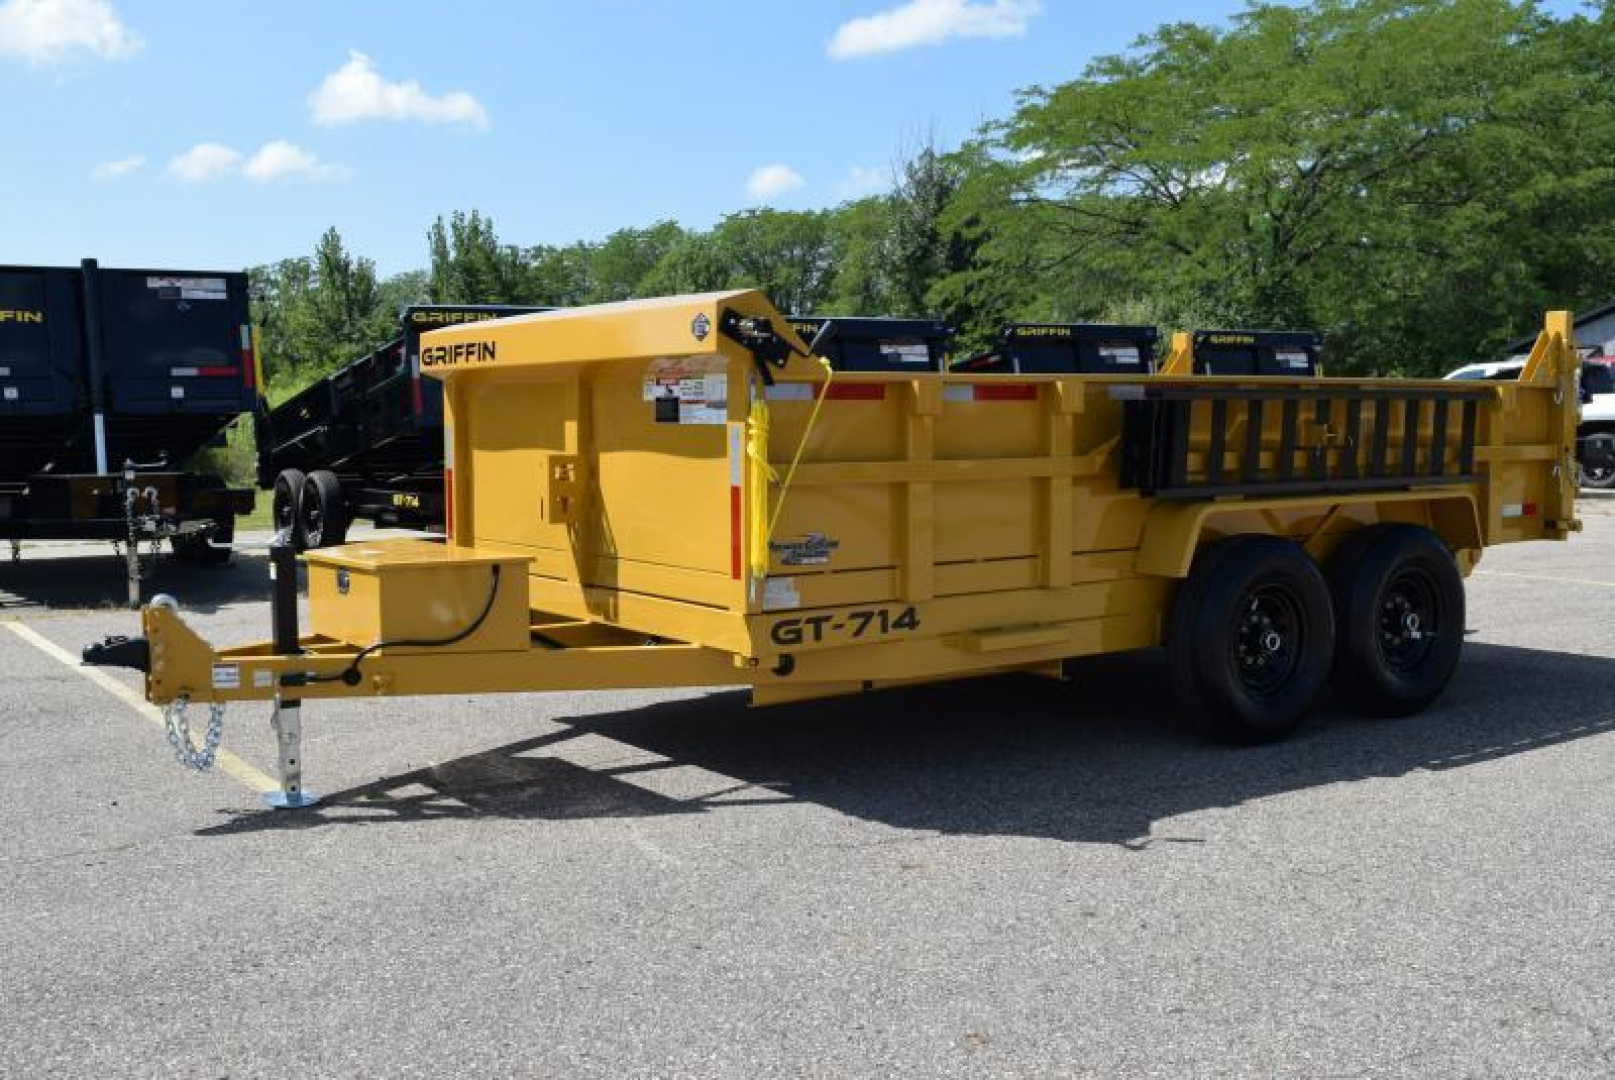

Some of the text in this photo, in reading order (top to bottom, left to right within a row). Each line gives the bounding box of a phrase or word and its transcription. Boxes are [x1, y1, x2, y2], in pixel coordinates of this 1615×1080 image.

[411, 312, 498, 323] GRIFFIN
[1016, 327, 1071, 336] GRIFFIN
[421, 340, 496, 366] GRIFFIN
[770, 606, 920, 645] GT-714
